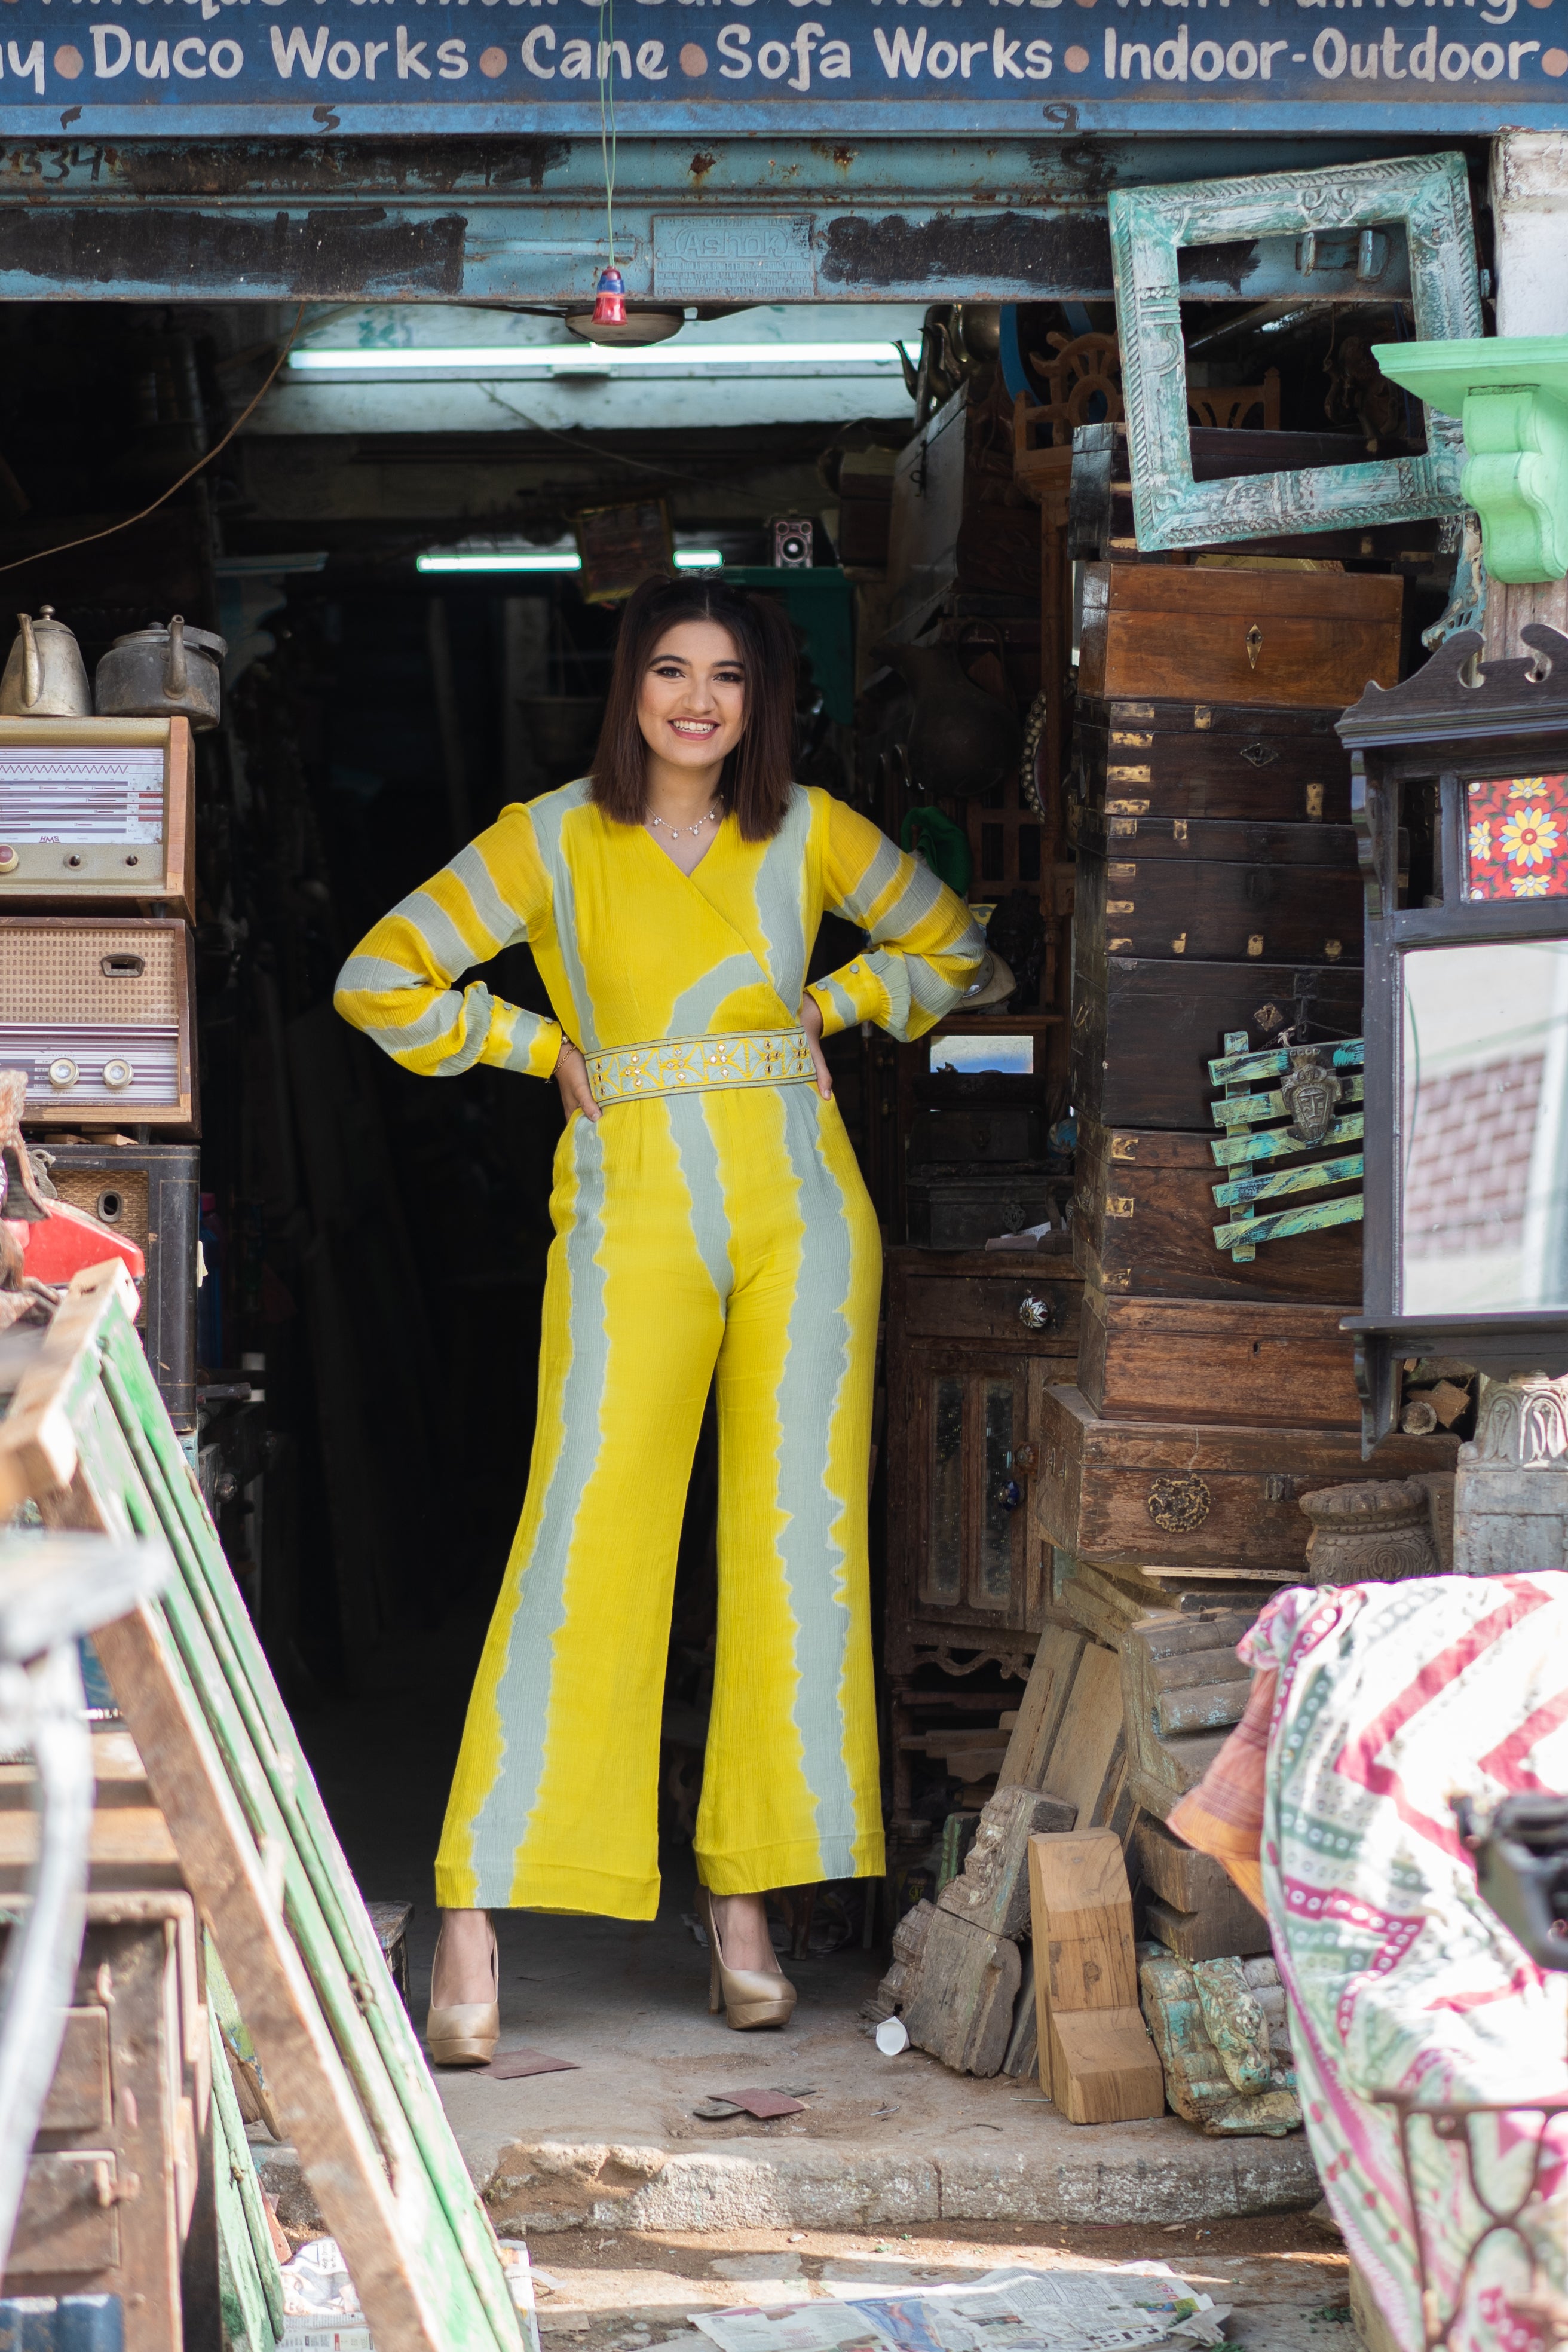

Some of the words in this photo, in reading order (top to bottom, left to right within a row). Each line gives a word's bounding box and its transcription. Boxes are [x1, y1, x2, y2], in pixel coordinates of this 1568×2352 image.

[0, 40, 45, 95] y
[89, 24, 244, 79] Duco
[270, 25, 469, 80] Works
[521, 24, 669, 80] Cane
[716, 22, 851, 92] Sofa
[873, 27, 1053, 79] Works
[1104, 26, 1541, 83] Indoor-Outdoor
[684, 231, 779, 258] Ashok
